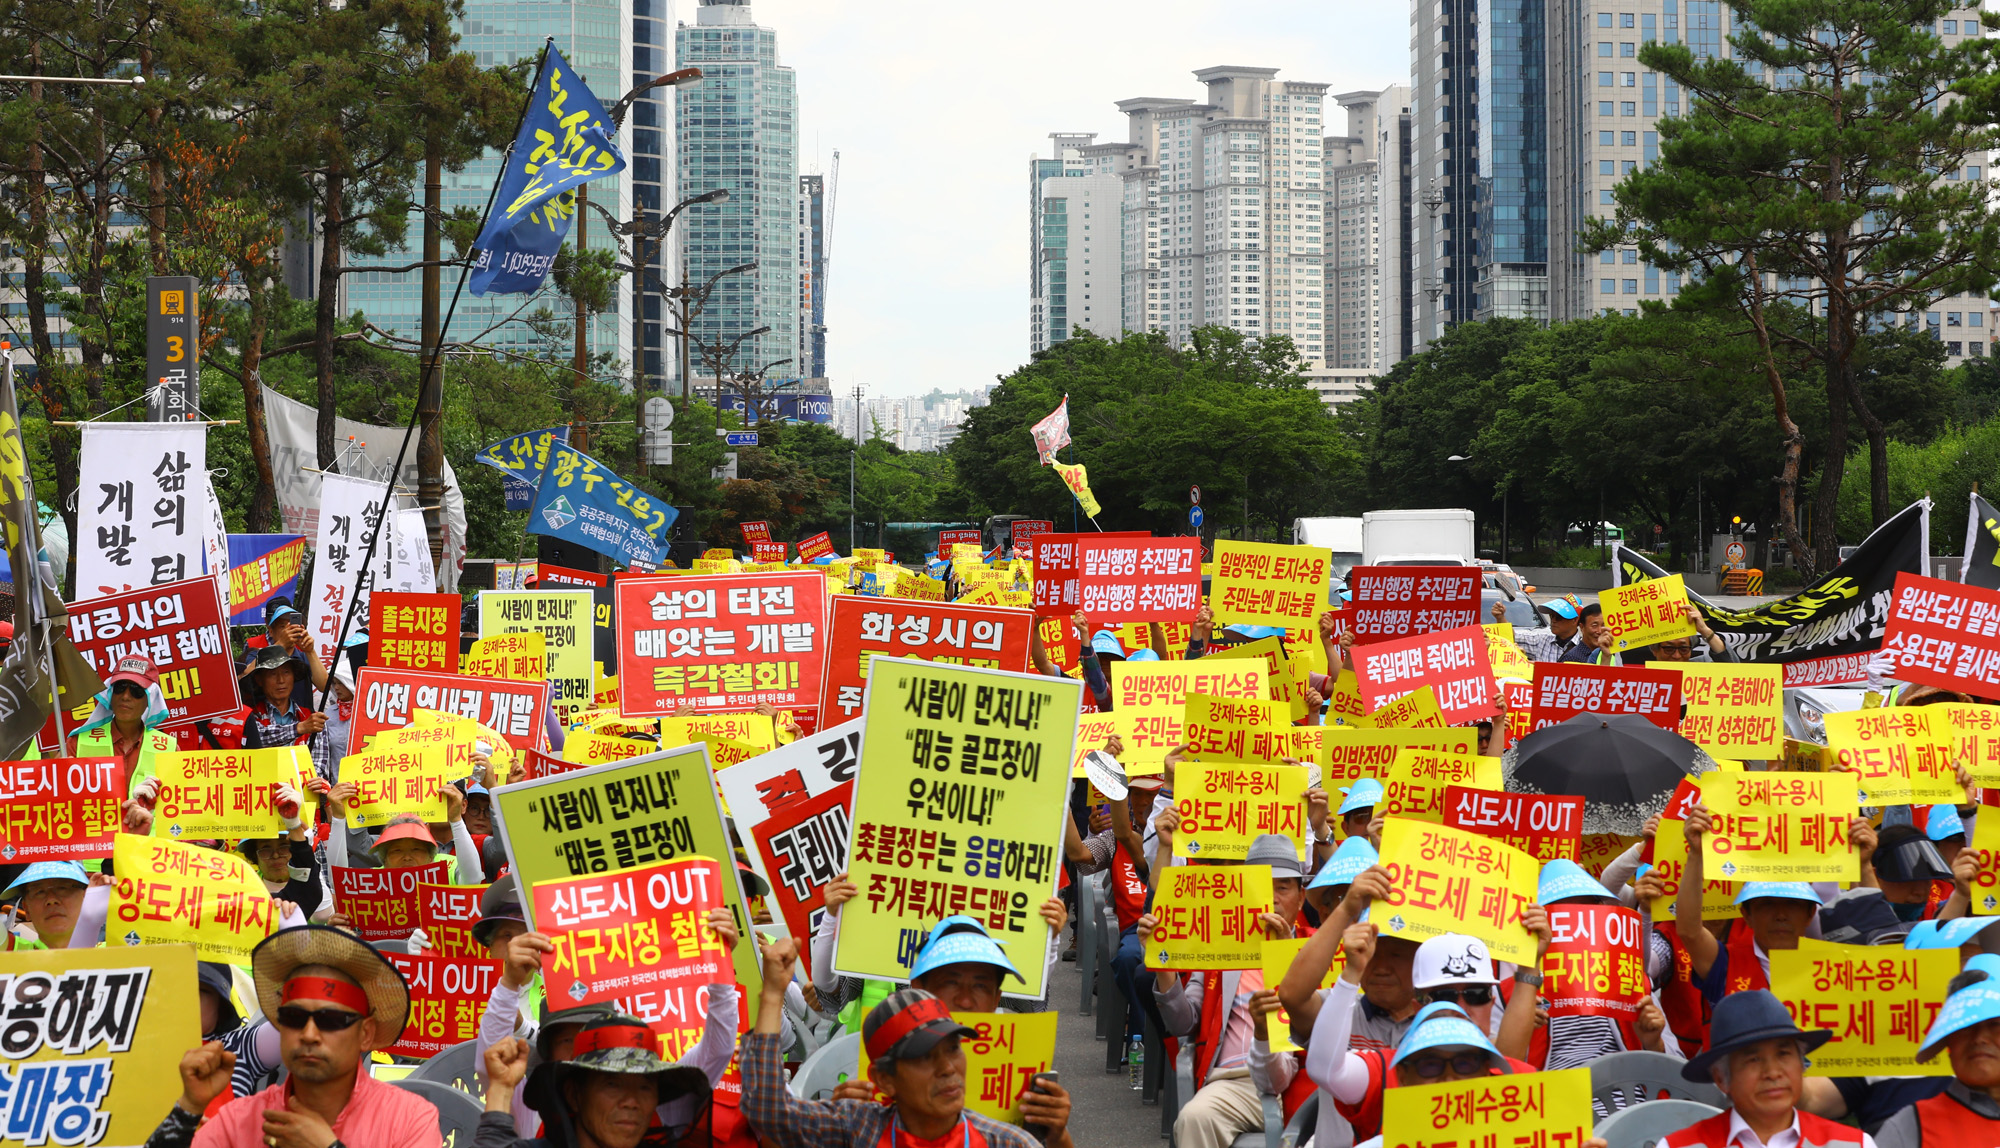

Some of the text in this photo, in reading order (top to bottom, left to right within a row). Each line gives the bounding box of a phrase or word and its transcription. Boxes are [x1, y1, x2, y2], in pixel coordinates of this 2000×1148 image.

[165, 335, 185, 363] 3
[553, 451, 604, 492] 광주
[151, 451, 191, 536] 삶의
[97, 480, 136, 567] 개발
[579, 504, 629, 533] 공공주택지구
[580, 522, 622, 545] 대책협의회
[328, 514, 351, 573] 개발
[755, 544, 785, 552] 강제수용
[755, 552, 785, 561] 결사반대
[1039, 543, 1072, 570] 원주민
[1085, 548, 1194, 576] 밀실행정 추진말고
[1219, 551, 1324, 585] 일방적인 토지수용
[649, 585, 796, 622] 삶의 터전
[1035, 579, 1061, 606] 언 놈
[1083, 583, 1197, 612] 양심행정 추진하라!
[1222, 586, 1316, 618] 주민눈엔 피눈물
[1358, 576, 1474, 602] 밀실행정 추진말고
[1618, 582, 1669, 607] 강제수용시
[382, 606, 448, 635] 졸속지정
[1356, 608, 1476, 635] 양심행정 추진하라!
[1606, 597, 1690, 637] 양도세 폐지
[1896, 586, 1968, 630] 원삼도심
[175, 624, 223, 662] 침해
[482, 637, 527, 655] 강제수용시
[634, 622, 816, 659] 빼앗는 개발
[860, 612, 1004, 651] 화성시의
[380, 639, 447, 669] 주택정책
[468, 656, 508, 678] 양도세
[513, 655, 543, 678] 폐지
[1366, 638, 1475, 685] 죽일테면 죽여라!
[1888, 631, 1957, 674] 수용도면
[652, 661, 800, 695] 즉각철회!
[1122, 674, 1188, 707] 일방적인
[1194, 672, 1259, 699] 토지수용
[1439, 676, 1488, 711] 나간다!
[1539, 675, 1673, 713] 밀실행정 추진말고
[1683, 676, 1776, 707] 의견 수렴해야
[366, 681, 410, 725] 이천
[486, 691, 535, 737] 개발
[656, 697, 676, 709] 어천
[727, 692, 796, 706] 주민대책위원회
[1209, 702, 1272, 726] 강제수용시
[90, 728, 107, 742] 투
[152, 735, 168, 751] 쟁
[398, 727, 455, 744] 강제수용시
[687, 720, 750, 740] 강제수용시
[1132, 716, 1184, 748] 주민눈
[1187, 724, 1290, 762] 양도세 폐지
[1717, 715, 1777, 746] 성취한다
[1856, 713, 1931, 741] 강제수용시
[182, 755, 252, 779] 강제수용시
[361, 752, 423, 775] 강제수용시
[588, 740, 650, 761] 강제수용시
[960, 733, 1041, 783] 골프장이
[1331, 743, 1398, 779] 일방적인
[1838, 743, 1911, 782] 양도세
[1916, 743, 1959, 783] 폐지
[0, 762, 116, 798] 신도시 OUT
[1204, 770, 1280, 795] 강제수용시
[1412, 756, 1476, 783] 강제수용시
[162, 783, 274, 819] 양도세 폐지
[347, 774, 443, 809] 양도세 폐지
[1736, 778, 1824, 807] 강제수용시
[0, 798, 122, 842] 지구지정 철회
[1179, 798, 1302, 838] 양도세 폐지
[1456, 793, 1576, 832] 신도시 OUT
[19, 843, 95, 856] 공공주택지구 전국연대 대책협의회
[611, 815, 697, 869] 골프장이
[1710, 811, 1853, 855] 양도세 폐지
[151, 846, 245, 884] 강제수용시
[855, 822, 1053, 884] 촛불정부는 응답하라!
[1419, 831, 1511, 879] 강제수용시
[341, 871, 393, 895] 신도시
[551, 867, 711, 926] 신도시 OUT
[1174, 872, 1243, 899] 강제수용시
[1388, 862, 1471, 922] 양도세
[1478, 886, 1534, 936] 폐지
[117, 877, 274, 938] 양도세 폐지
[342, 897, 408, 926] 지구지정
[867, 873, 1029, 933] 주거복지로드맵은
[1153, 904, 1271, 944] 양도세 폐지
[1604, 912, 1641, 949] OUT
[550, 909, 727, 978] 지구지정 철회
[442, 963, 495, 995] OUT
[591, 965, 692, 993] 공공주택지구 전국연대 대책협의회
[1811, 958, 1918, 992] 강제수용시
[1784, 999, 1875, 1046] 양도세
[1430, 1081, 1545, 1131] 강제수용시
